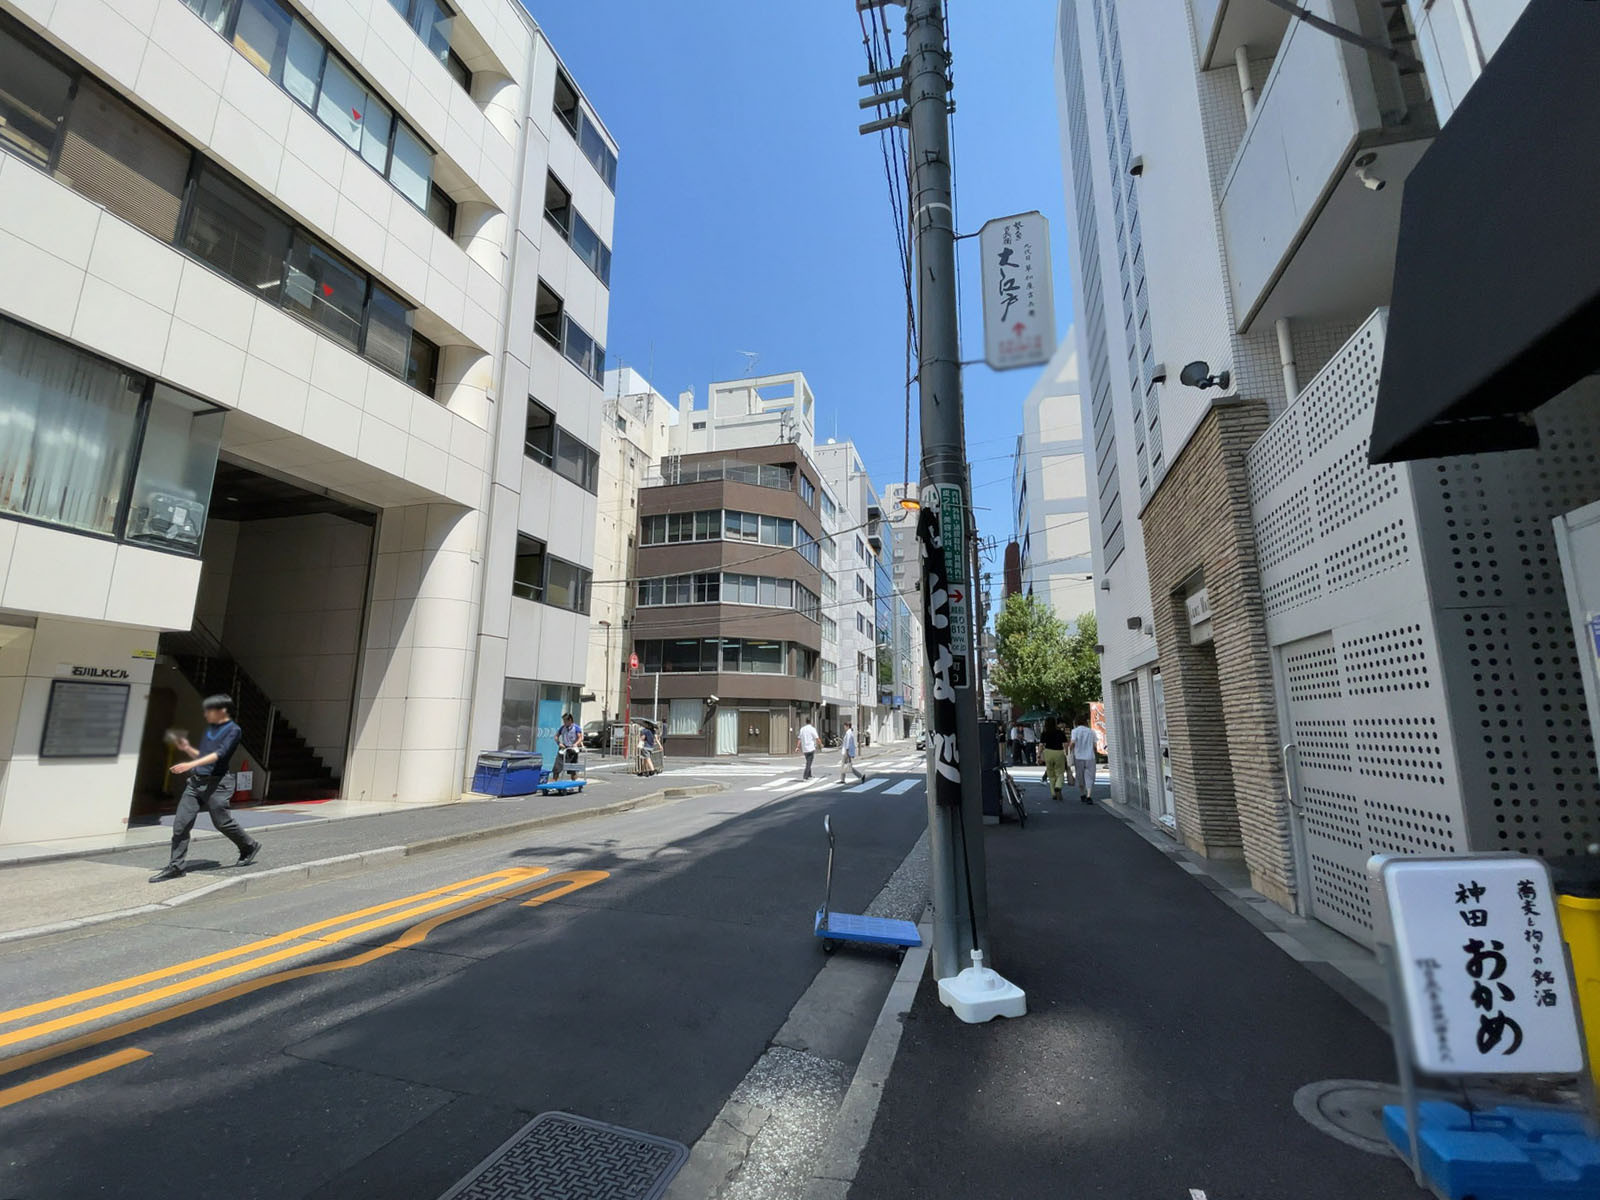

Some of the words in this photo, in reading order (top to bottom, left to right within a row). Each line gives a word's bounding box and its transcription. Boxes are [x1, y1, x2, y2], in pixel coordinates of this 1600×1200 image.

[996, 246, 1021, 323] 大江戸
[72, 666, 130, 679] 石川LKビル
[1455, 880, 1488, 927] 神田
[1517, 879, 1557, 1007] 蕎麦と拘りの銘酒
[1462, 938, 1523, 1055] おかめ
